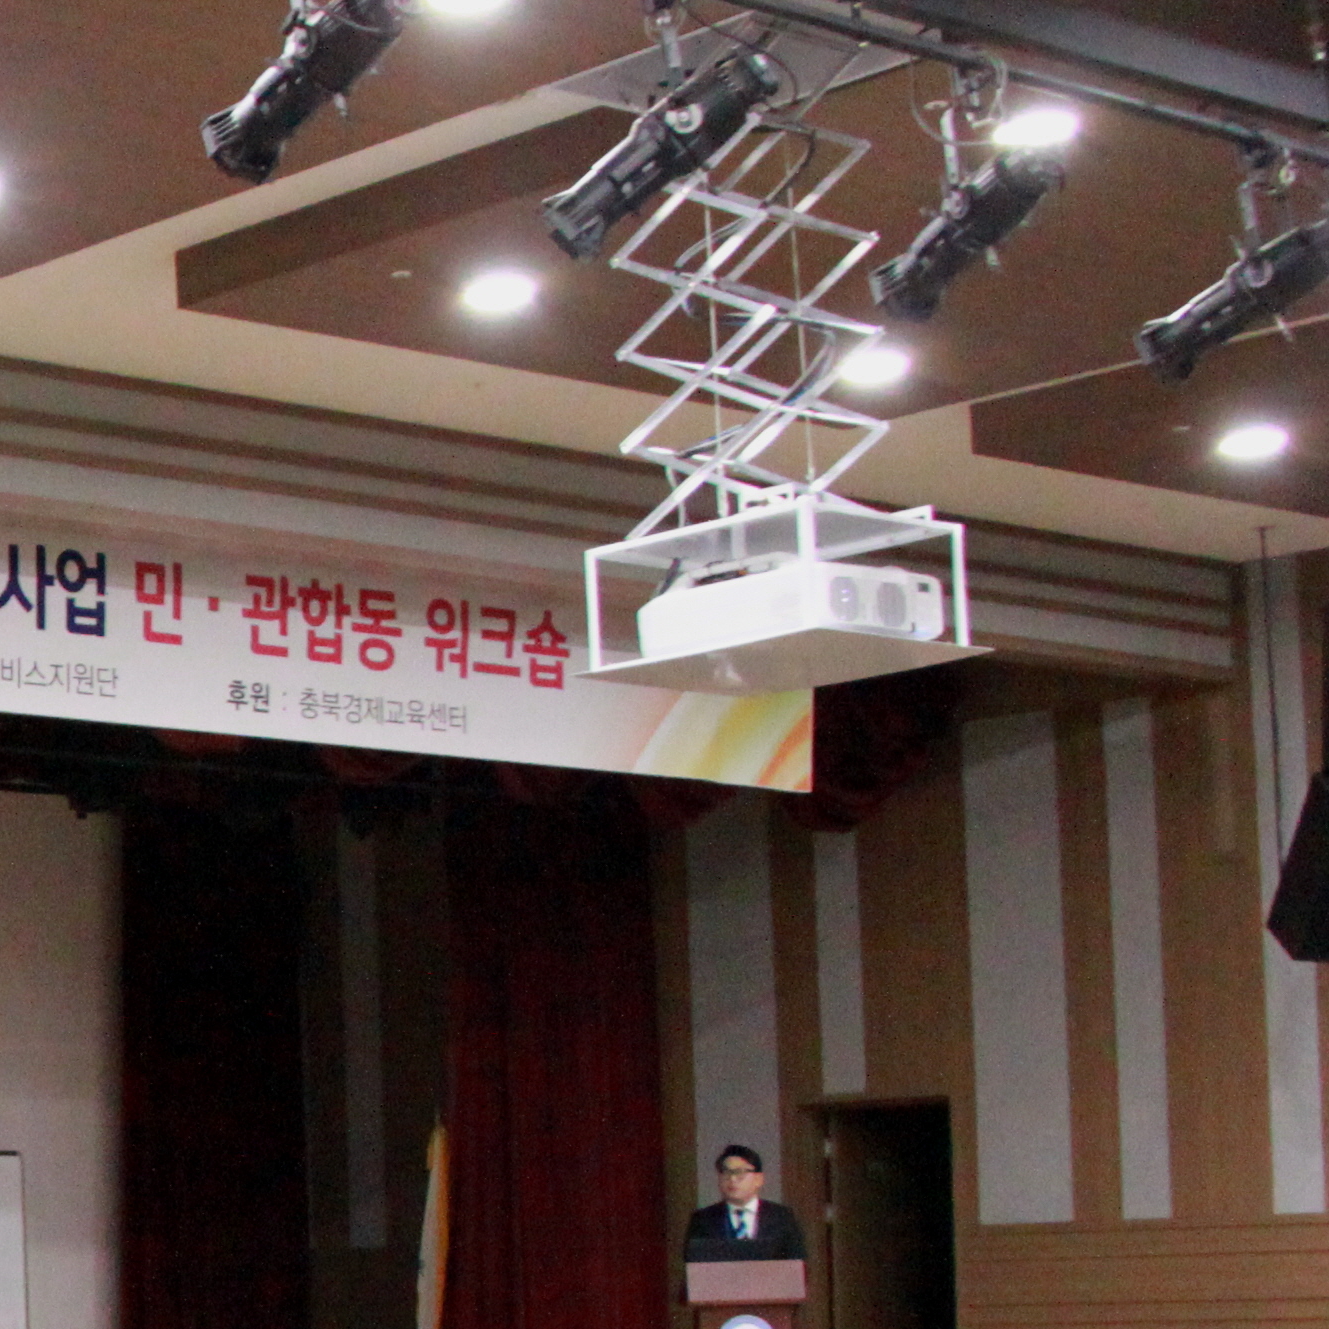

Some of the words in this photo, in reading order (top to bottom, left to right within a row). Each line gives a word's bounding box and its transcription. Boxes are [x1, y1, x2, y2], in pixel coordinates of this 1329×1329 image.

[424, 597, 571, 690] 워크숍
[227, 679, 270, 714] 후원
[299, 687, 468, 734] 충북경제교육센터
